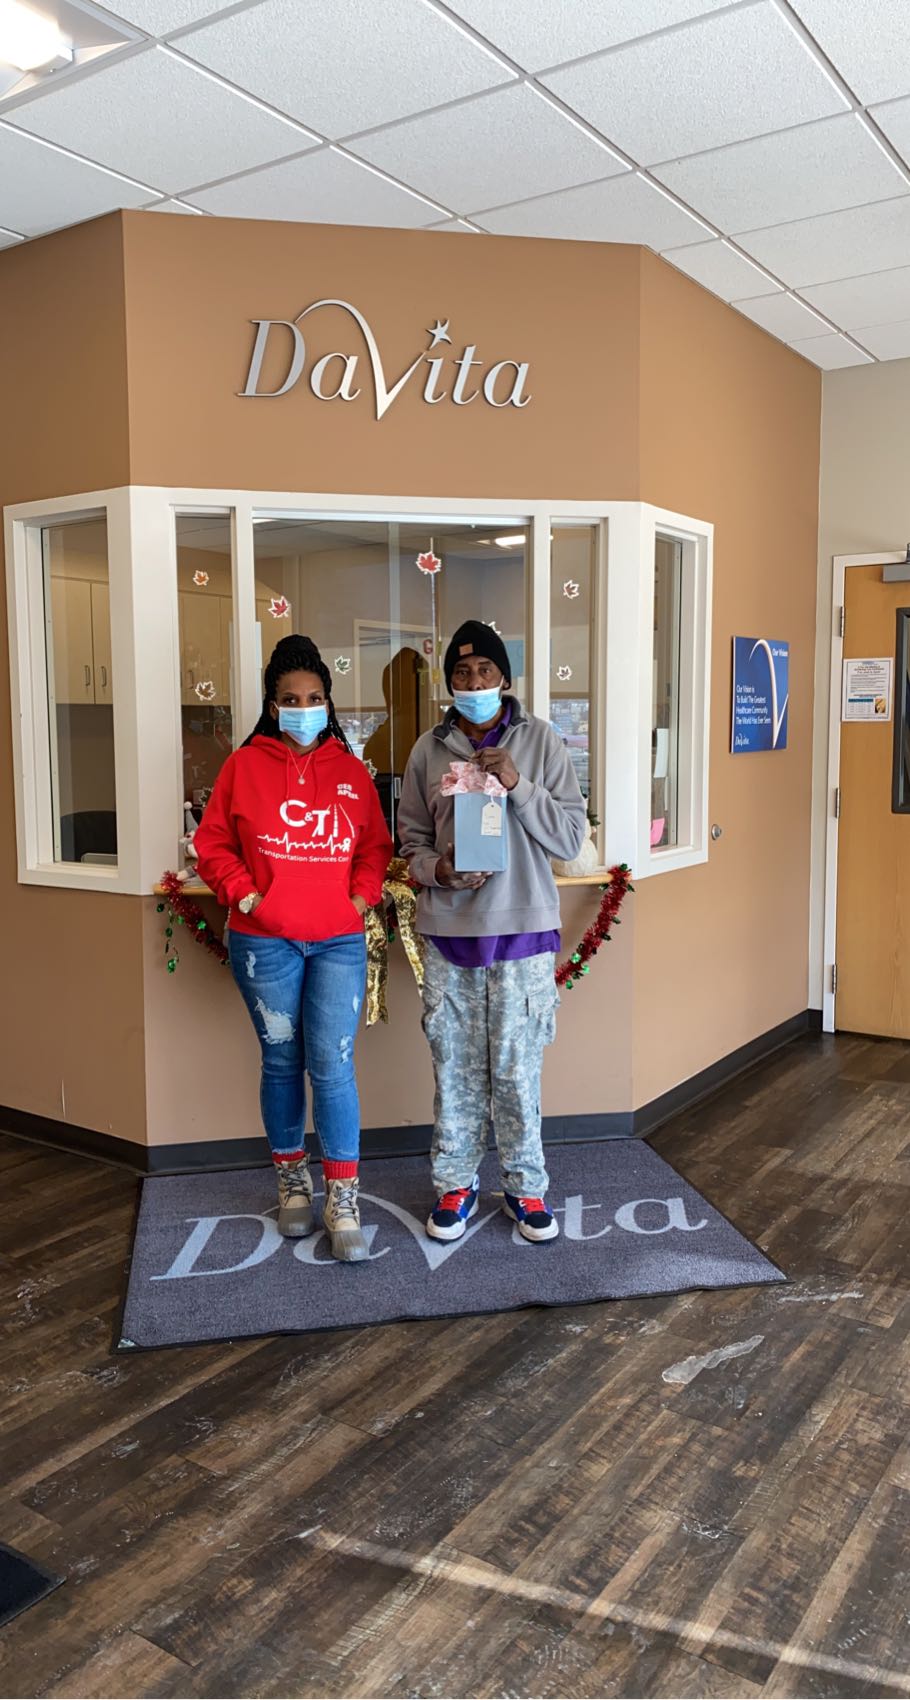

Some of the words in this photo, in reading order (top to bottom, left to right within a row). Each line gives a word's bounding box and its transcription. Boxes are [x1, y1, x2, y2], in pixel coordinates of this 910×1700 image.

[237, 299, 532, 420] DaVita
[743, 685, 752, 693] Vision
[736, 706, 751, 714] Healthcare
[752, 706, 768, 715] Community
[257, 847, 308, 862] Transportation
[150, 1190, 708, 1281] DaVta
